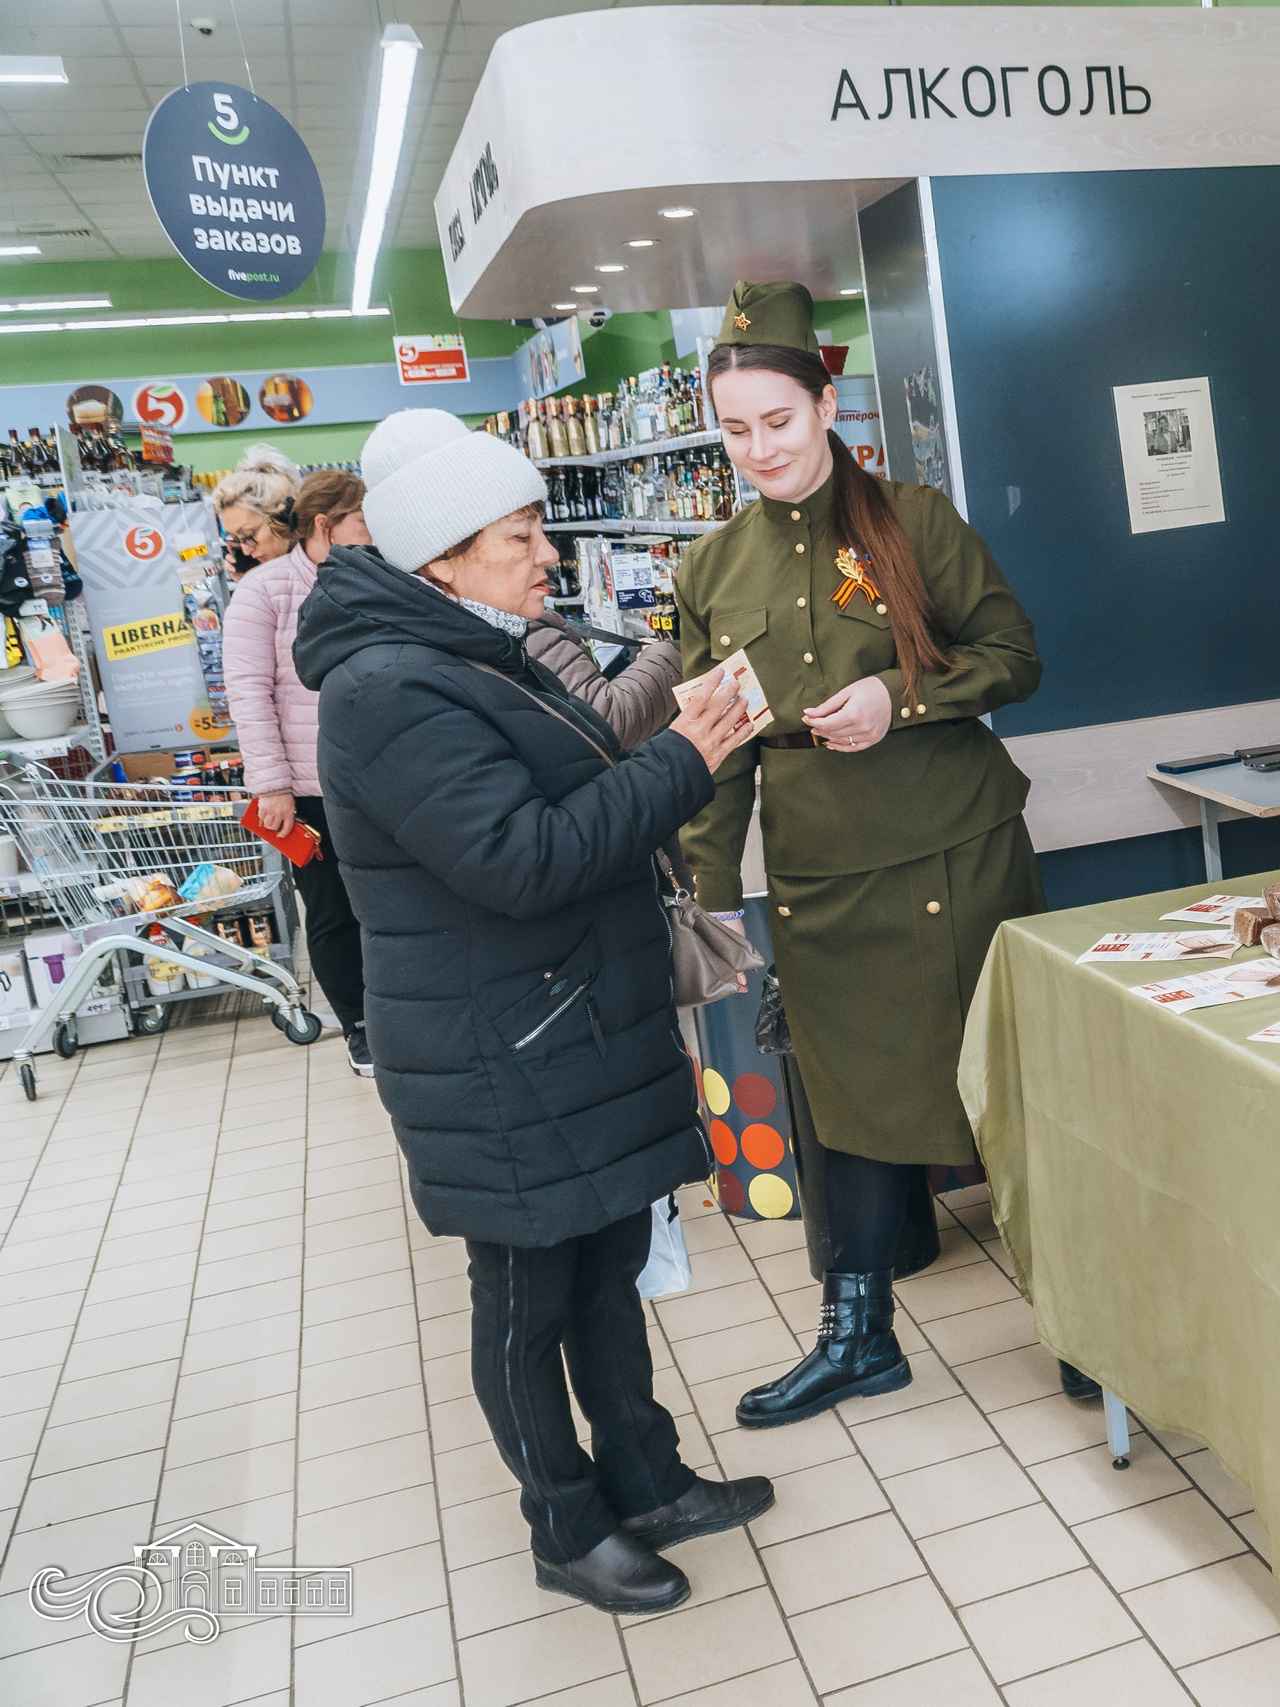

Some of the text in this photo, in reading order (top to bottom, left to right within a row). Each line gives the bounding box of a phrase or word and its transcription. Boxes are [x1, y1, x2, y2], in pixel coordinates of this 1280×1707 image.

[830, 64, 1152, 121] АЛКОГОЛЬ
[213, 93, 239, 130] 5
[192, 155, 280, 190] Пункт
[189, 194, 296, 223] выдачи
[193, 227, 302, 255] заказов
[228, 269, 280, 283] fivepost.ru
